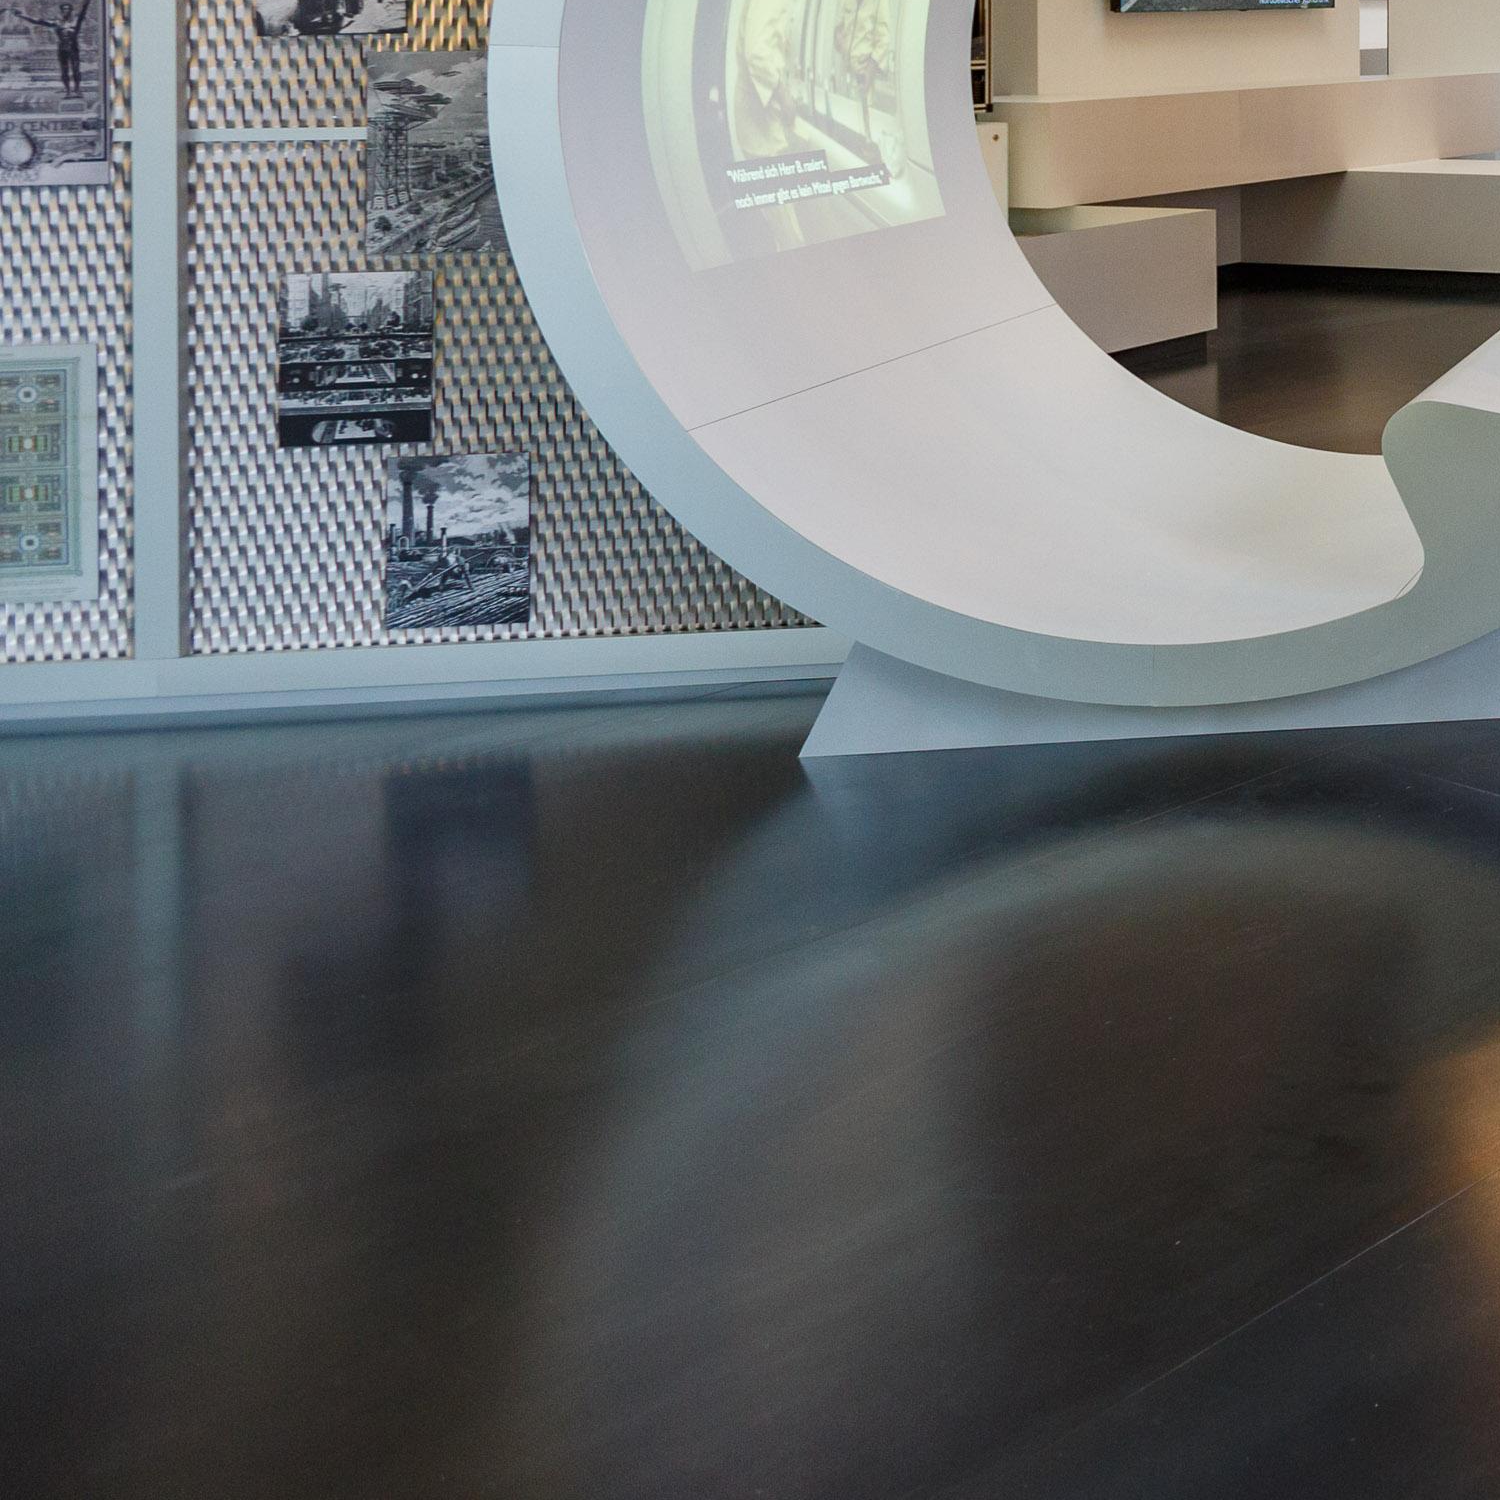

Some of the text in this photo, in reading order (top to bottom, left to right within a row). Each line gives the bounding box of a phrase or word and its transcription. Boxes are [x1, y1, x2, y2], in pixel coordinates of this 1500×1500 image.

[20, 121, 80, 132] CENTRE
[764, 164, 779, 180] sich
[778, 162, 796, 177] Herr
[753, 192, 777, 206] immer
